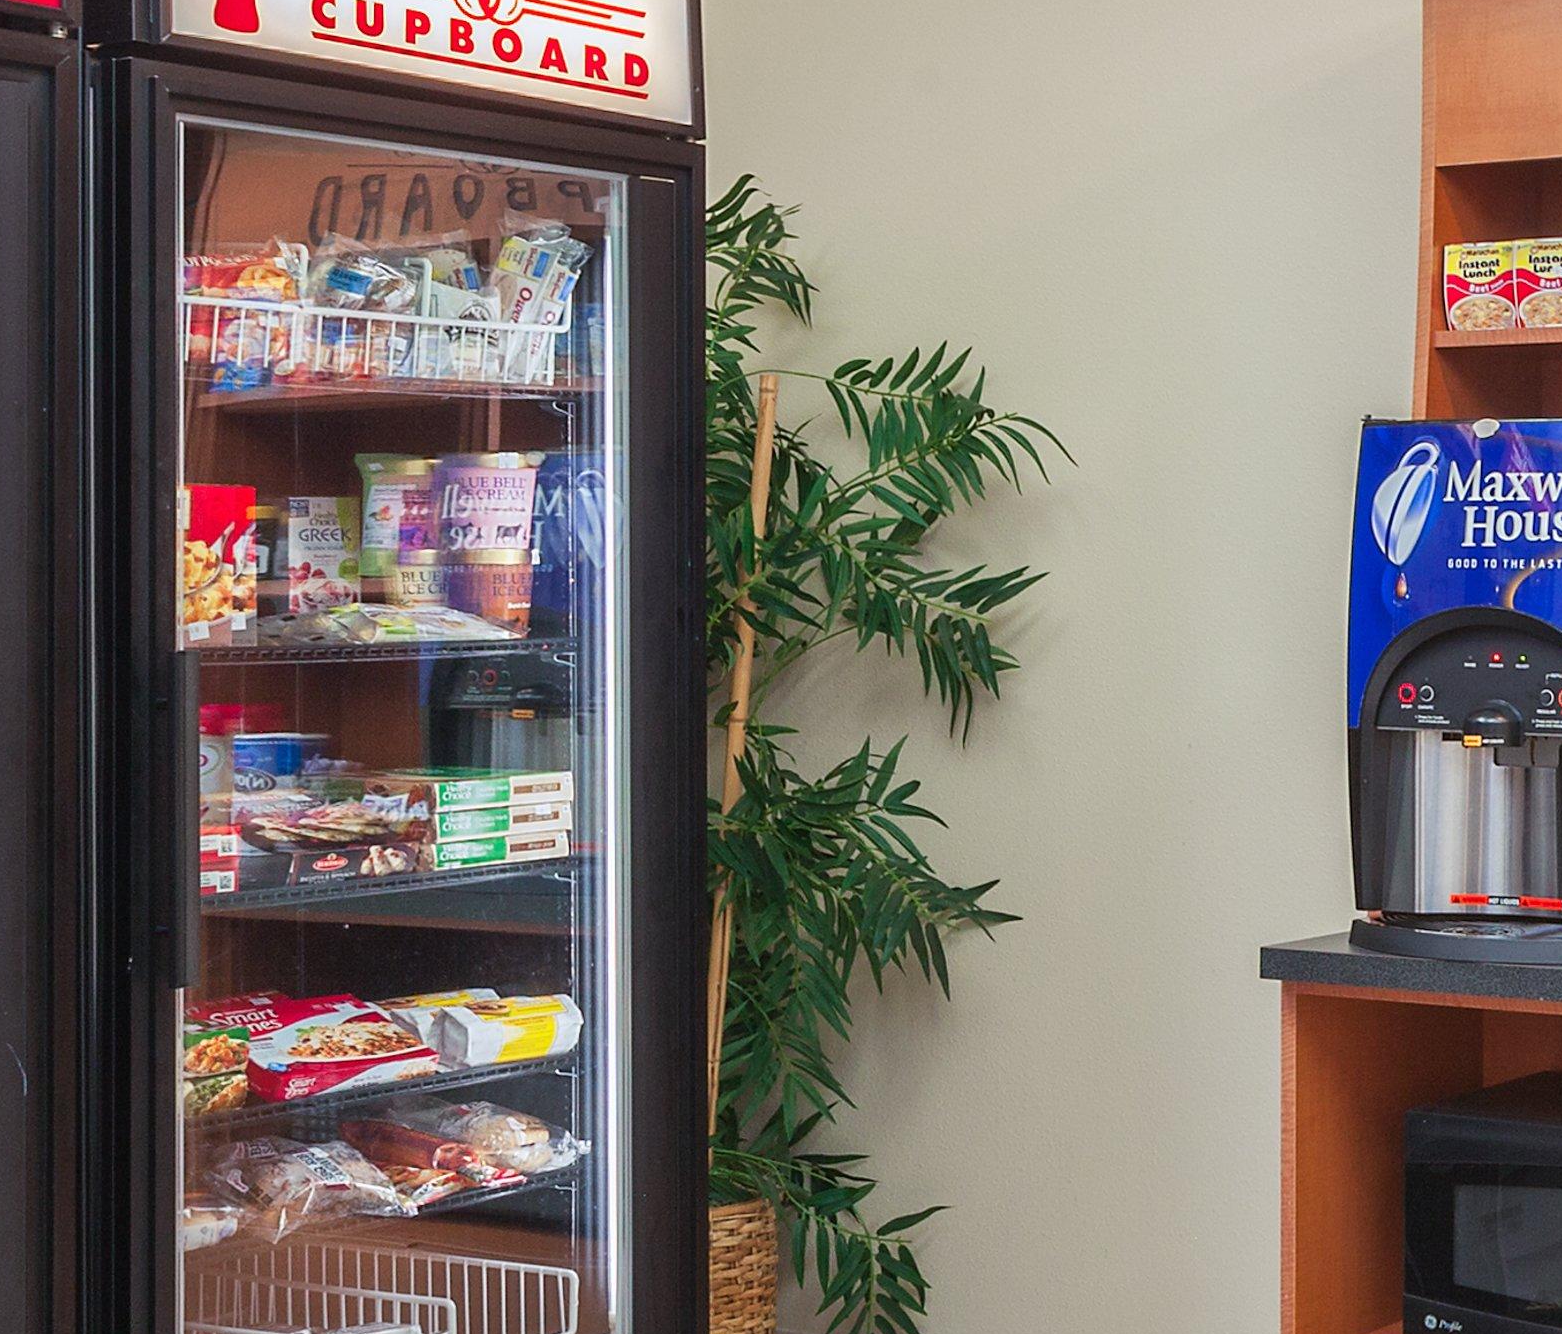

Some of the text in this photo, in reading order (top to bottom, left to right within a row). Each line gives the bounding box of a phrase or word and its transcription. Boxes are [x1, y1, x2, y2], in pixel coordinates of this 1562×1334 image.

[1459, 260, 1500, 269] Instant
[1463, 269, 1496, 278] Lunch
[492, 476, 528, 489] BELL
[299, 527, 352, 543] GREEK
[1447, 558, 1480, 570] GOOD
[1484, 559, 1498, 569] TO
[1503, 559, 1526, 569] THE
[1531, 559, 1562, 570] LAST
[209, 1007, 277, 1032] Smart
